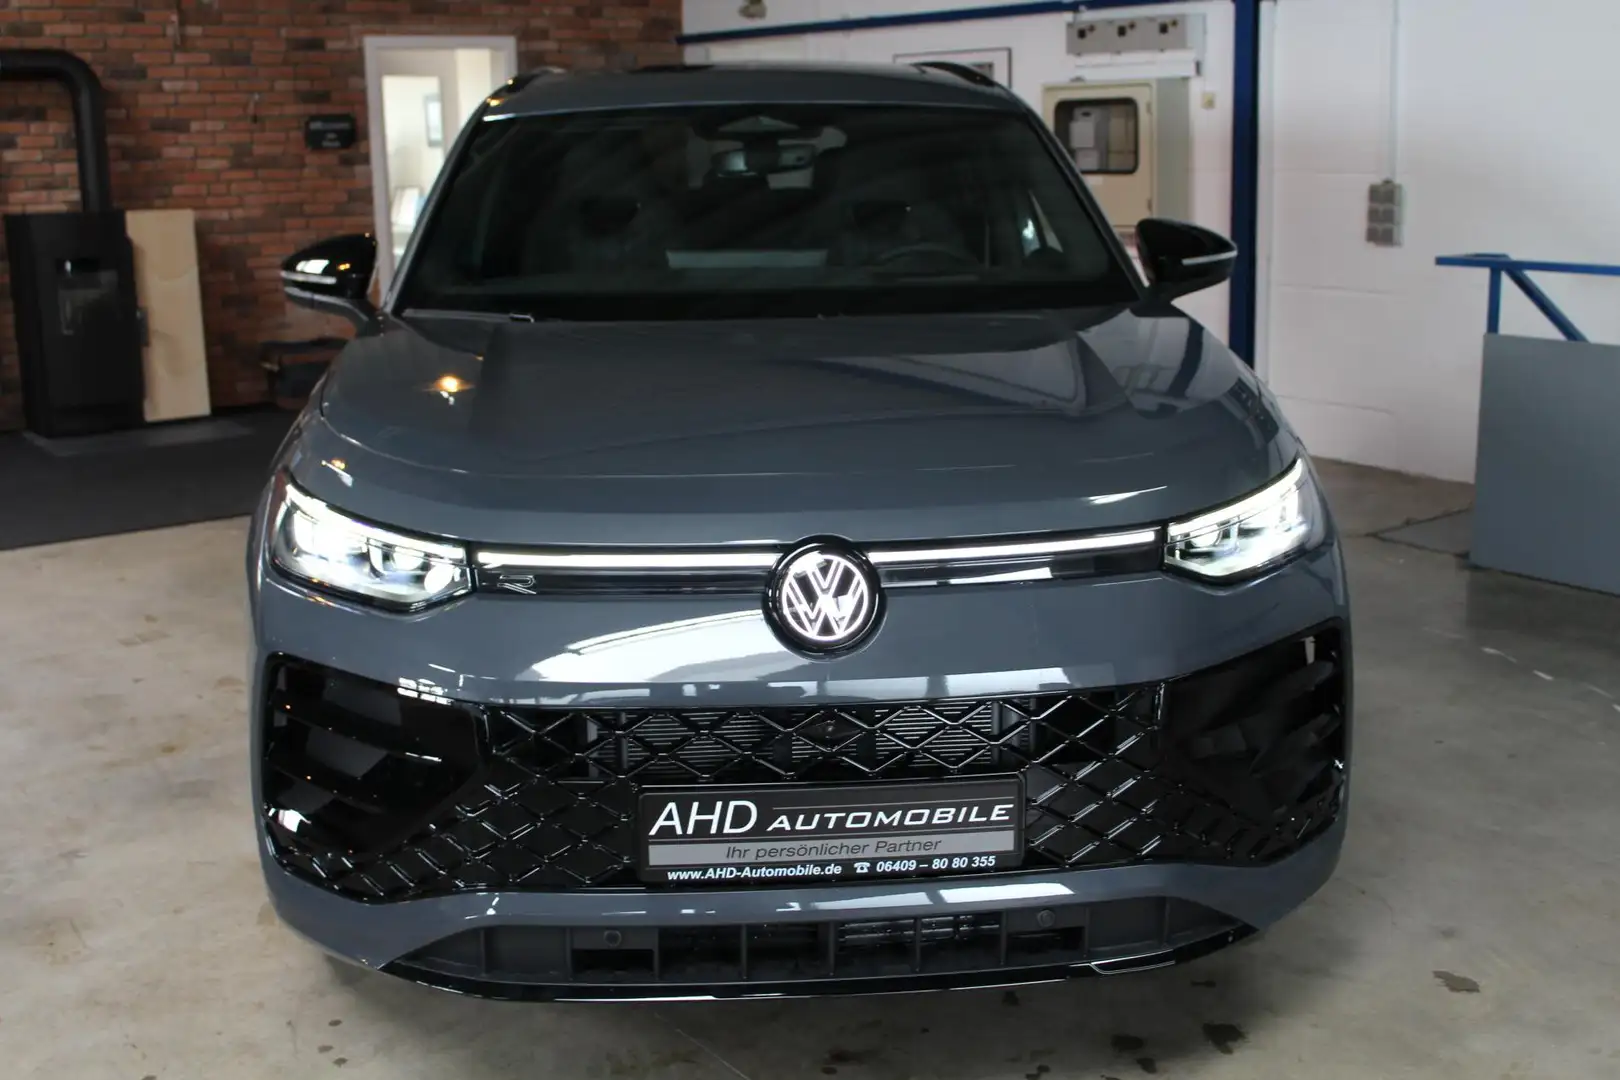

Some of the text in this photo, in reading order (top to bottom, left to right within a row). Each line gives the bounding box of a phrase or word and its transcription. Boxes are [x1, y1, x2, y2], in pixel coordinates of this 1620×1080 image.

[782, 554, 869, 642] VW
[648, 800, 1014, 836] AHD AUTOMOBILE
[726, 839, 942, 860] Ihr persönlicher Partner
[667, 863, 842, 880] www.AHD-Automobile.de
[876, 860, 917, 872] 06409
[932, 857, 948, 870] 80
[952, 856, 968, 869] 80
[971, 855, 996, 868] 355
